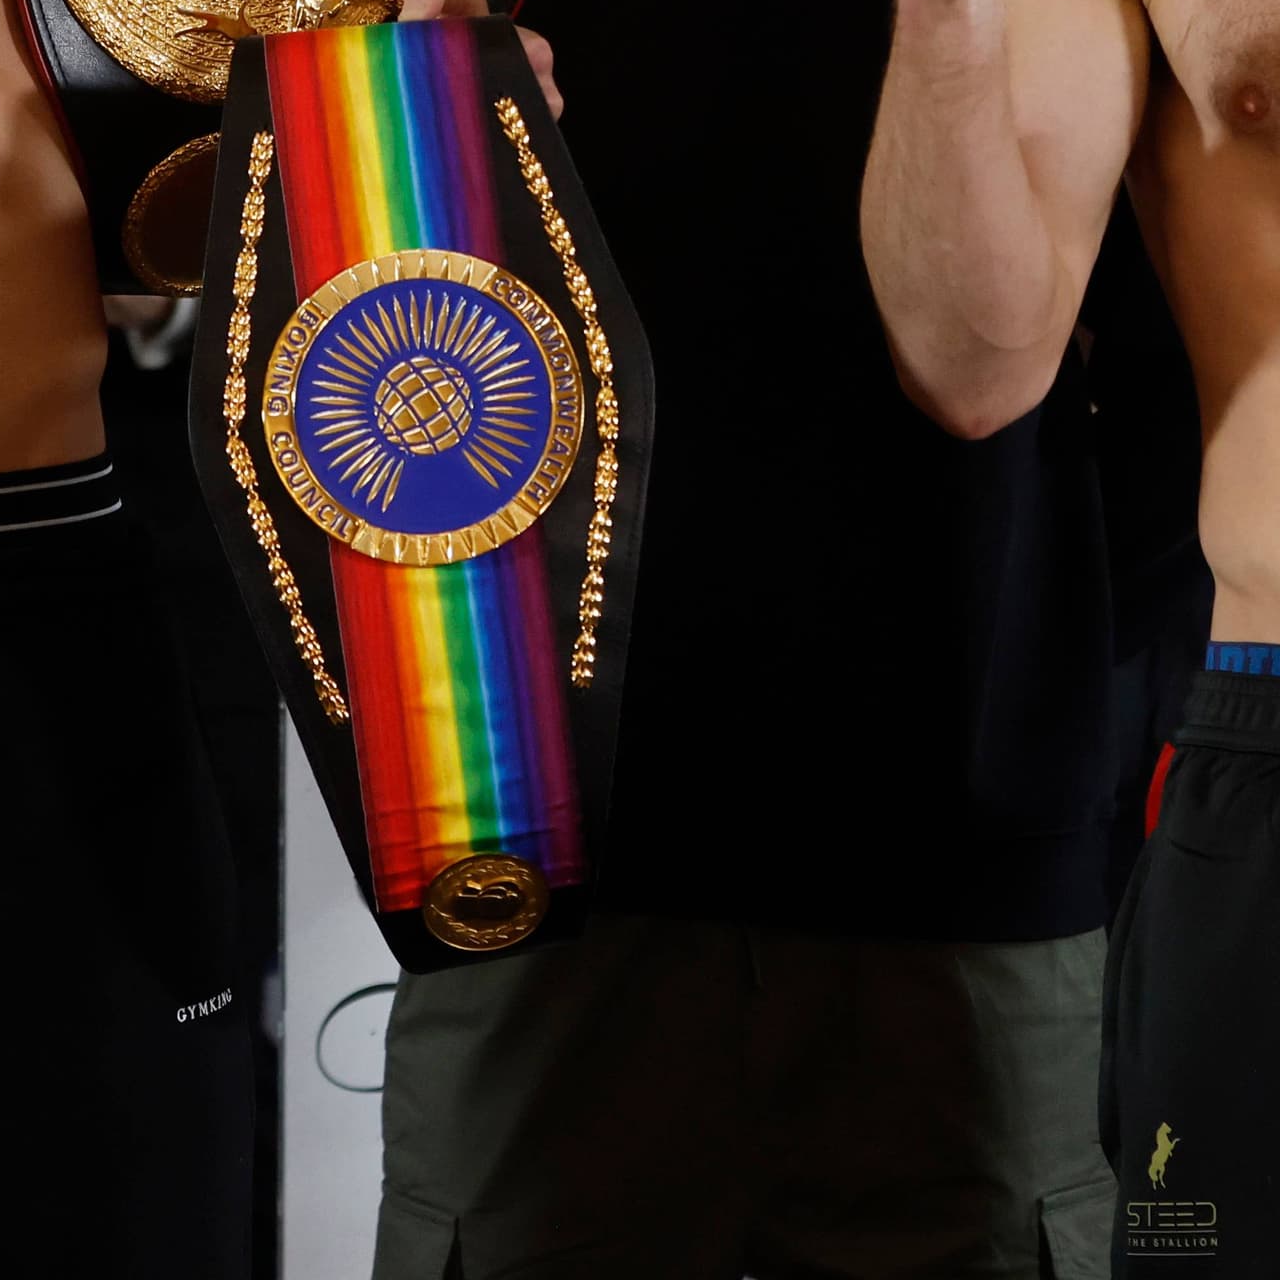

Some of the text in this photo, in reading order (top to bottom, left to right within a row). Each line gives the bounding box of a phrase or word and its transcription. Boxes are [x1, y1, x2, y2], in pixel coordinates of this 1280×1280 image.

[490, 276, 580, 506] COMMONWEALTH
[266, 306, 357, 540] BOXING COUNCIL
[176, 987, 233, 1024] GYMKING
[1126, 1201, 1218, 1228] STEED
[1127, 1236, 1219, 1248] THE STALLION
